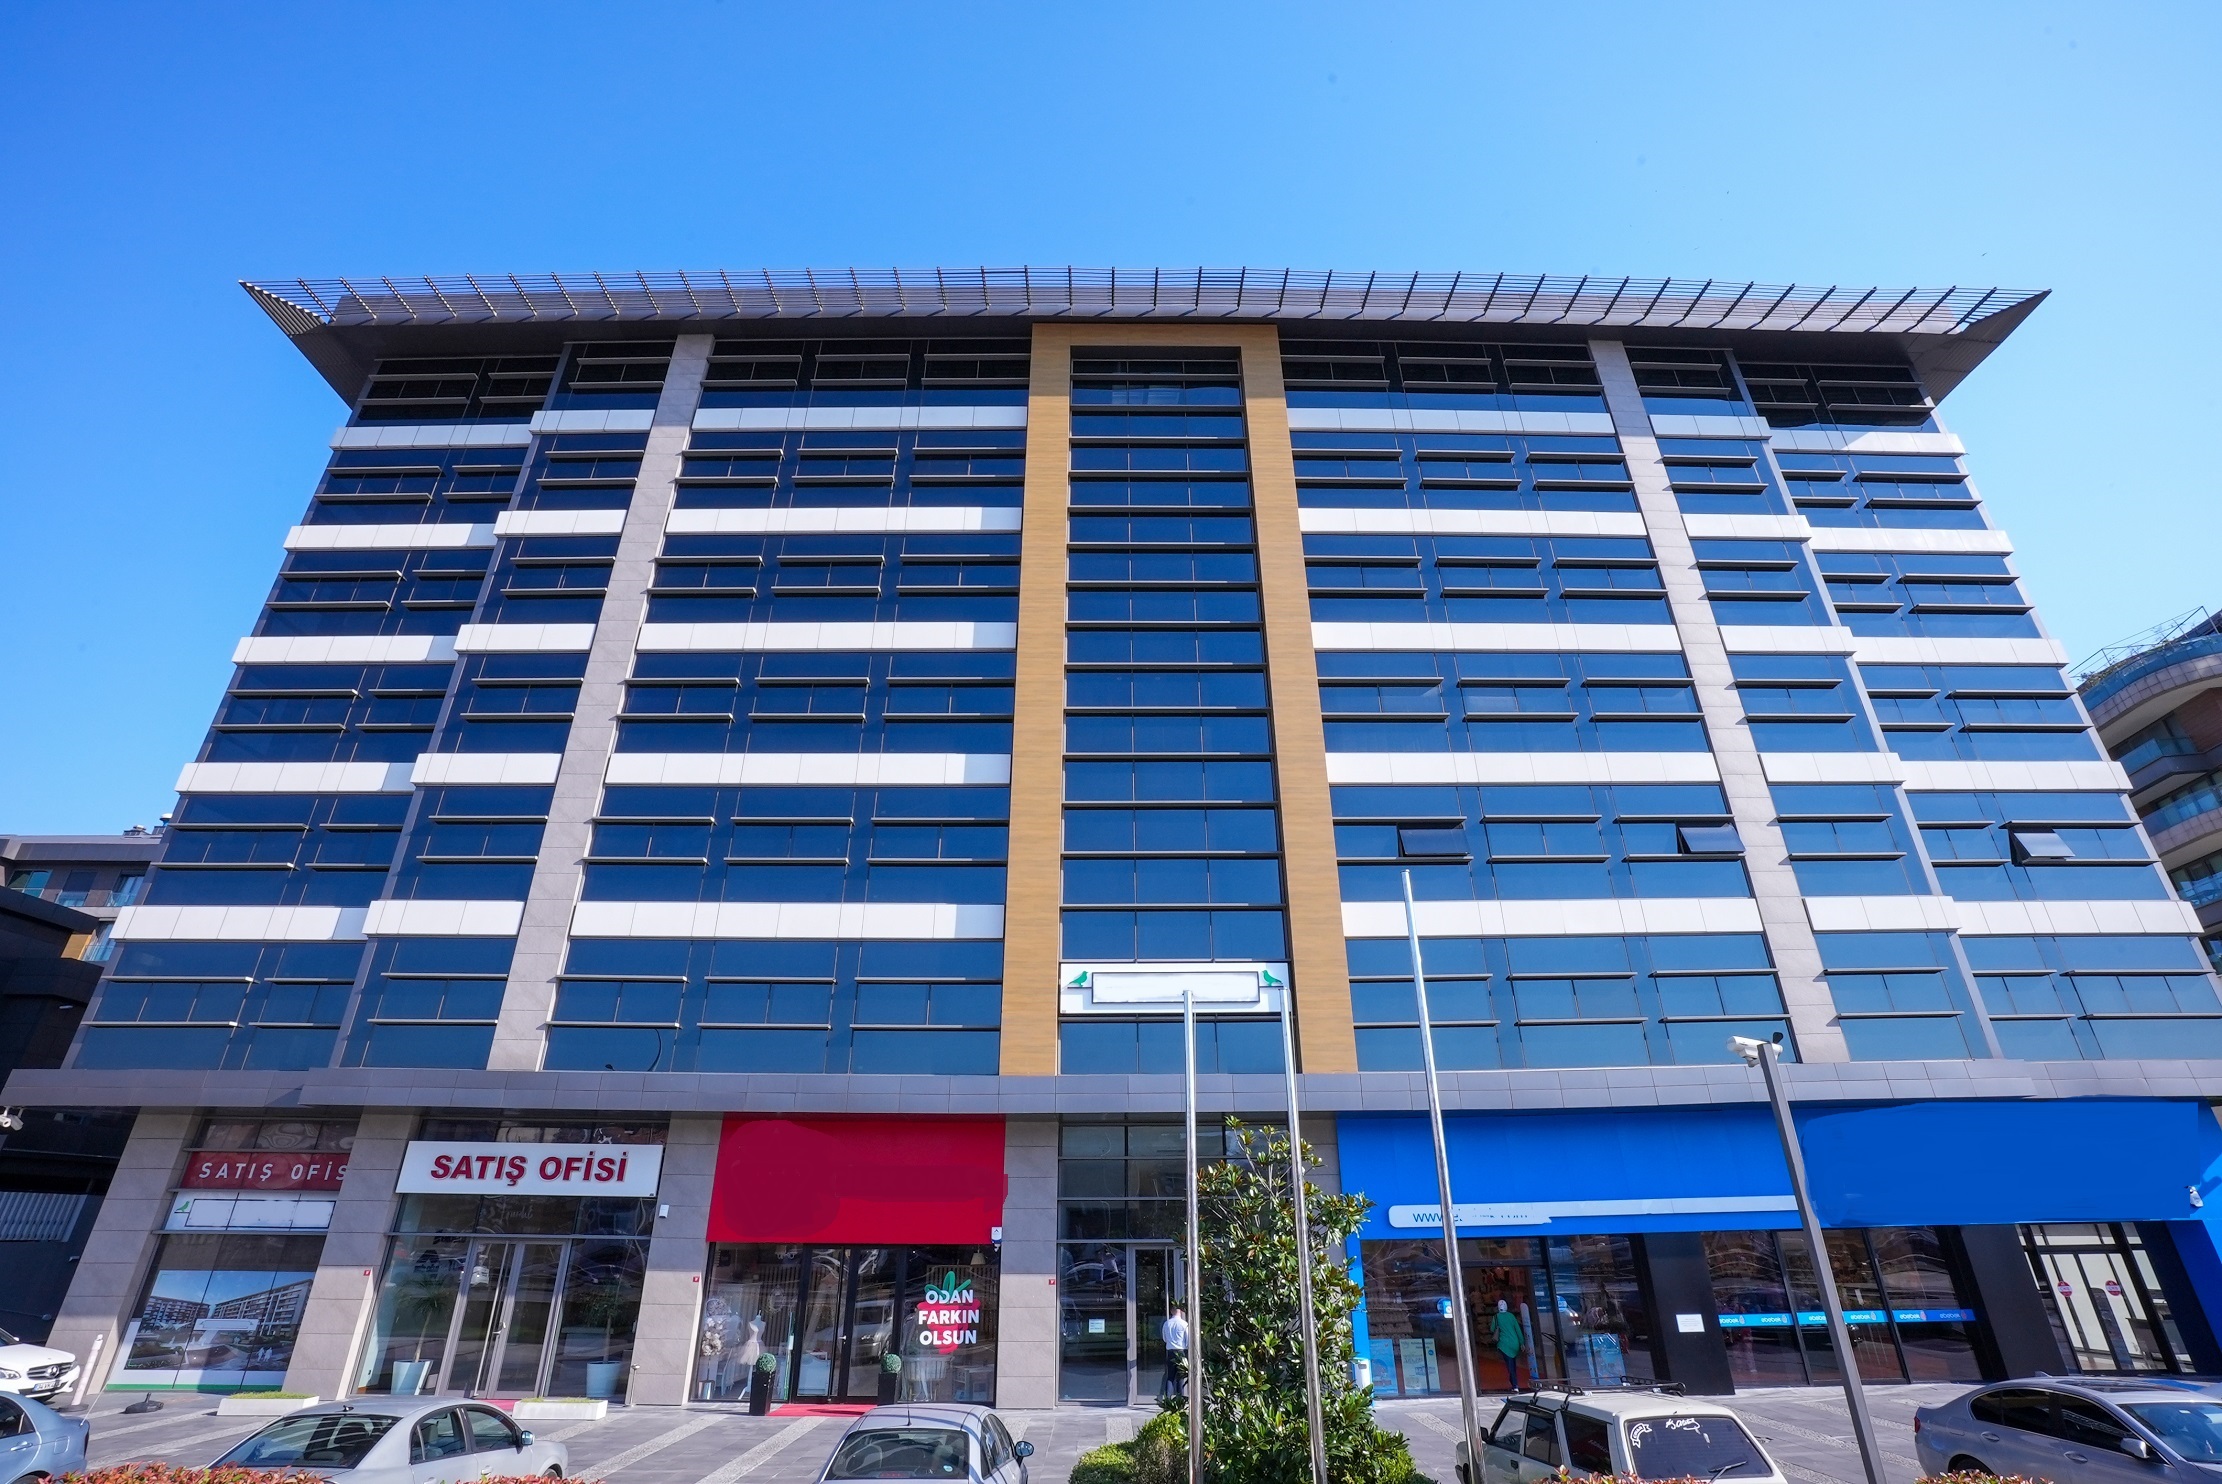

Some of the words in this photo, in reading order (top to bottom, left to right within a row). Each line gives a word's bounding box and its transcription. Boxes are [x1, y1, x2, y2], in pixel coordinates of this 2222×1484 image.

[198, 1162, 273, 1182] SATIŞ
[430, 1154, 528, 1186] SATIŞ
[539, 1150, 630, 1182] OFİSİ
[925, 1289, 974, 1305] ODAN
[918, 1309, 980, 1325] FARKIN
[919, 1329, 977, 1346] OLSUN
